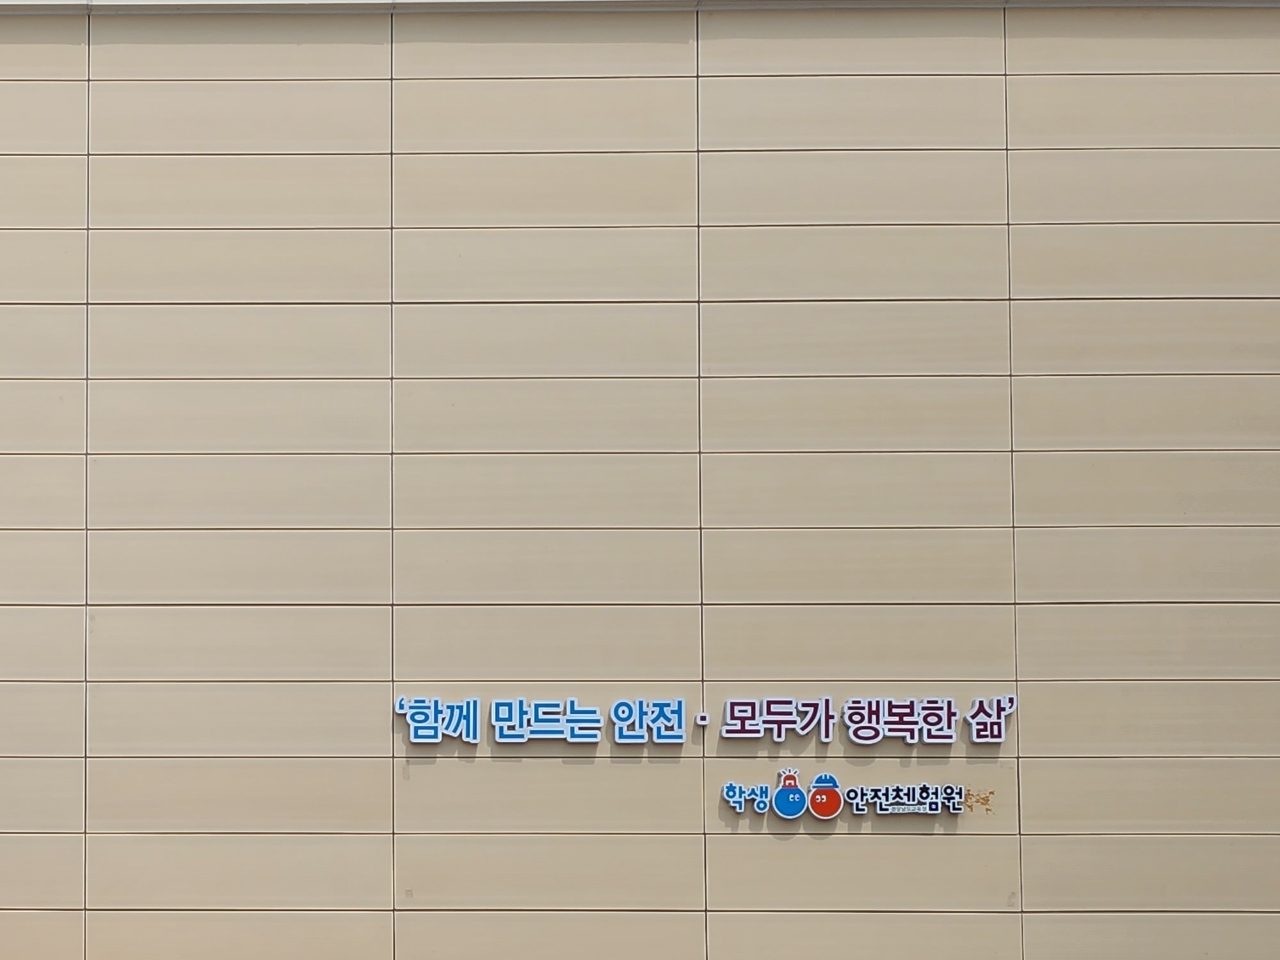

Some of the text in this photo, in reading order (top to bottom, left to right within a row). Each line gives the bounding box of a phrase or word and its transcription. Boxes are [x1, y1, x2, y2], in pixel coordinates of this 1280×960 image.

[493, 698, 602, 741] 만드는
[612, 699, 685, 741] 안전
[723, 698, 835, 741] 모두가
[845, 699, 957, 742] 행복한
[724, 783, 964, 813] 학생 안전체험원
